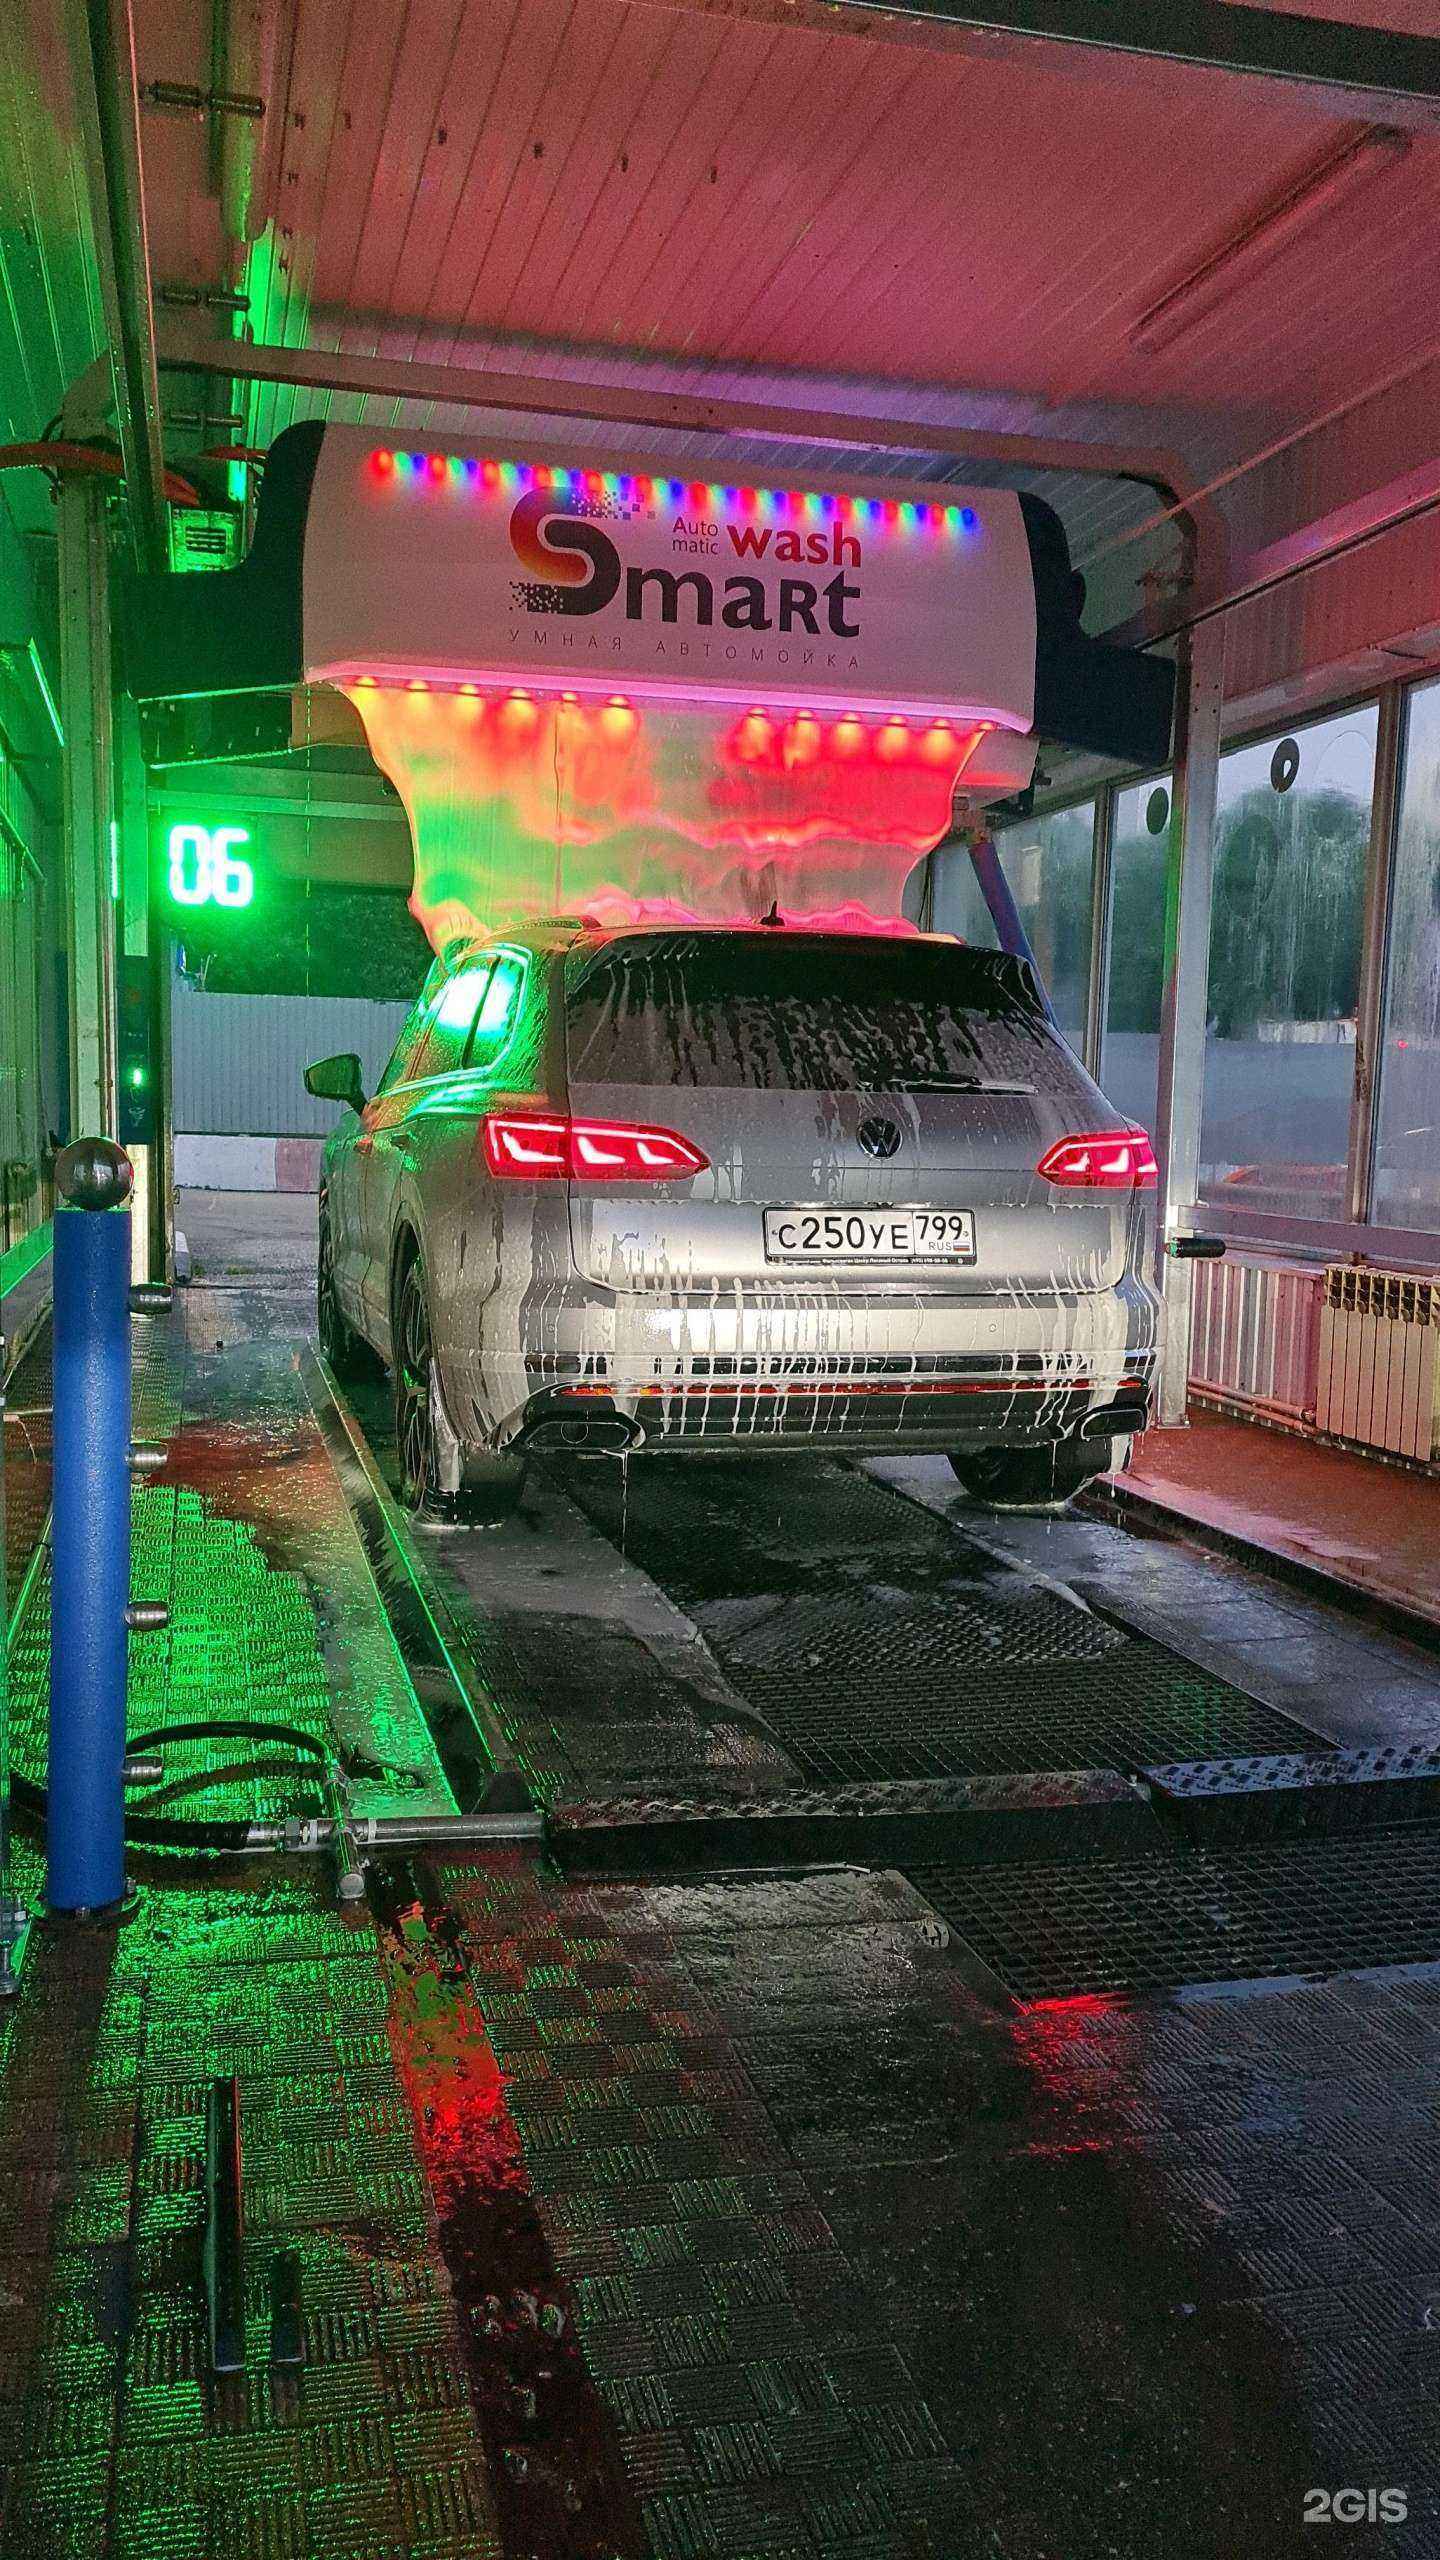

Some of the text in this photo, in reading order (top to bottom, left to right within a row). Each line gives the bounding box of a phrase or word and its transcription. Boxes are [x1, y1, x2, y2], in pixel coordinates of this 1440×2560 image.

[672, 516, 719, 537] Auto
[672, 538, 719, 556] matic
[726, 521, 862, 568] wash
[510, 628, 622, 652] УМНАЯ
[656, 640, 860, 670] АВТОМОЙКА
[168, 825, 254, 908] 06
[915, 1215, 964, 1241] 799
[928, 1241, 952, 1251] RUS
